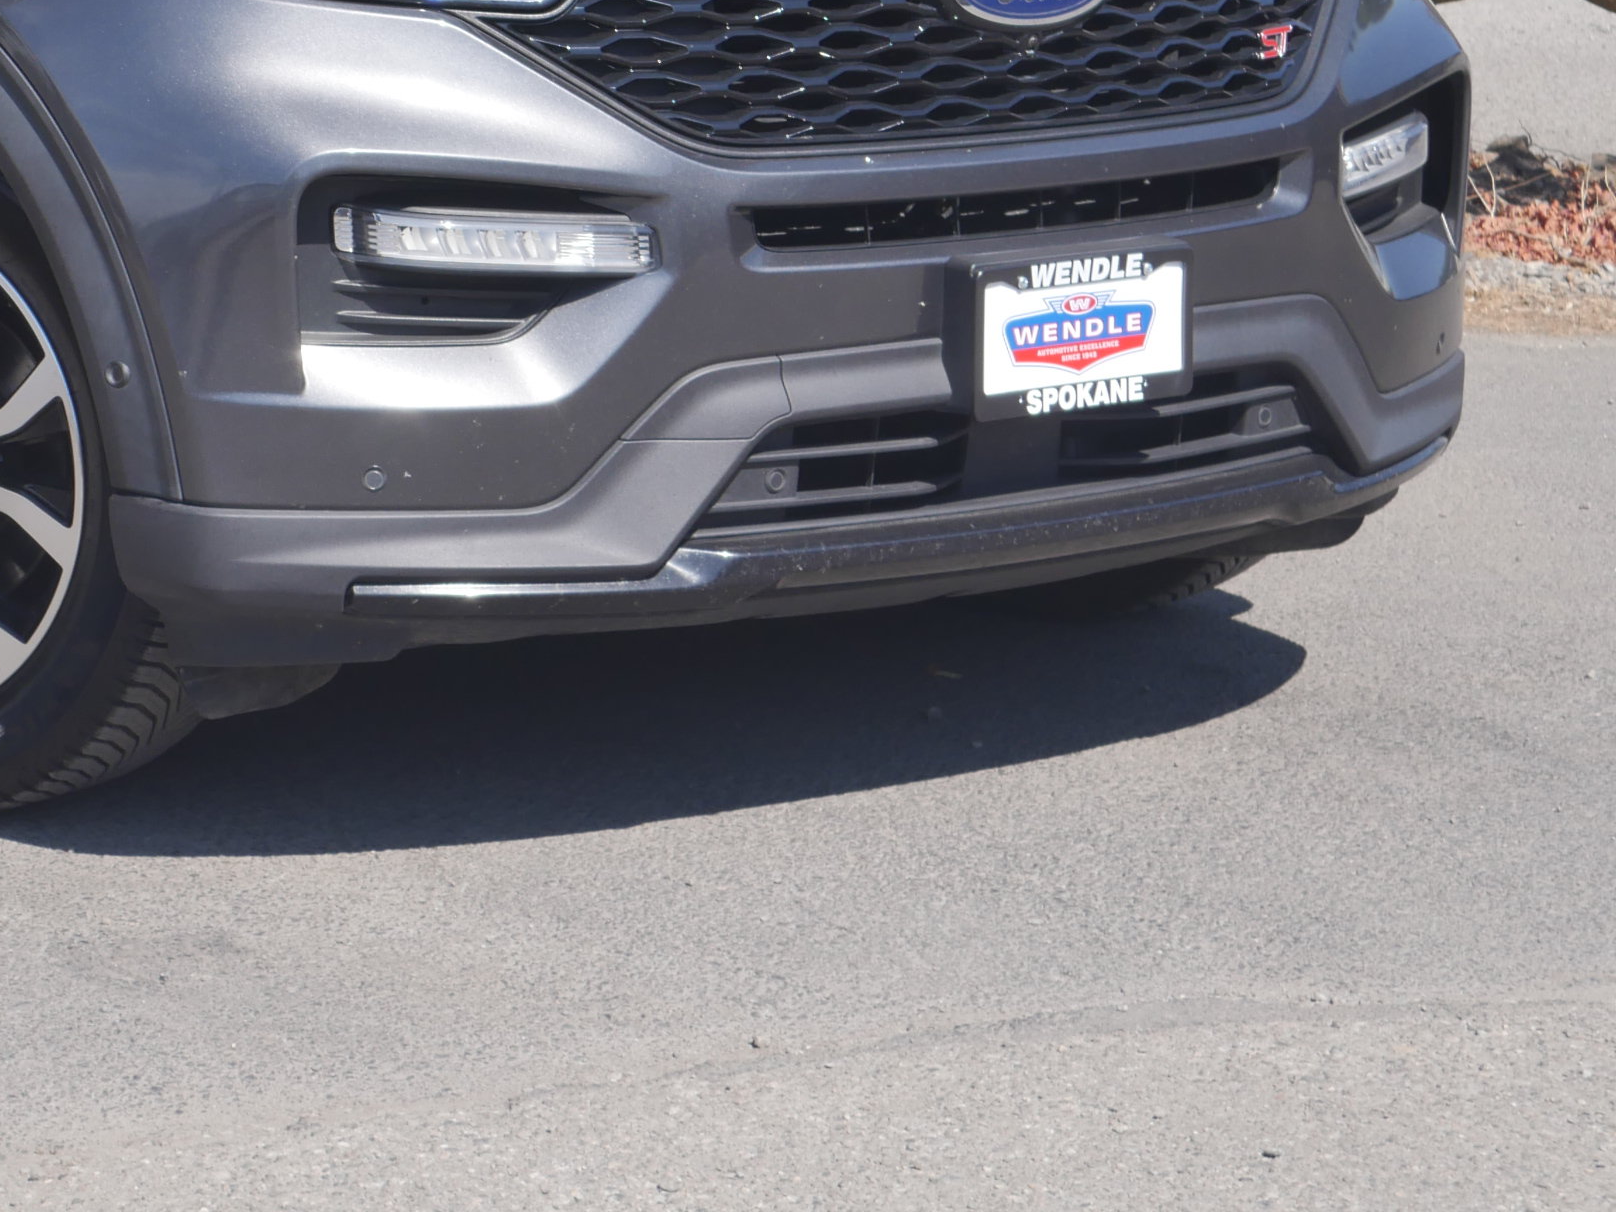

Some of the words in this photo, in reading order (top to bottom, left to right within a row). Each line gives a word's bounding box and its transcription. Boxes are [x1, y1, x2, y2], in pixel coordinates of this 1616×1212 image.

[1257, 24, 1293, 59] ST
[1031, 253, 1143, 288] WENDLE
[1013, 313, 1142, 345] WENDLE
[1037, 345, 1078, 356] AUTOMOTIVE
[1079, 340, 1120, 351] EXCELLENCE
[1061, 352, 1081, 362] SINCE
[1025, 376, 1145, 415] SPOKANE
